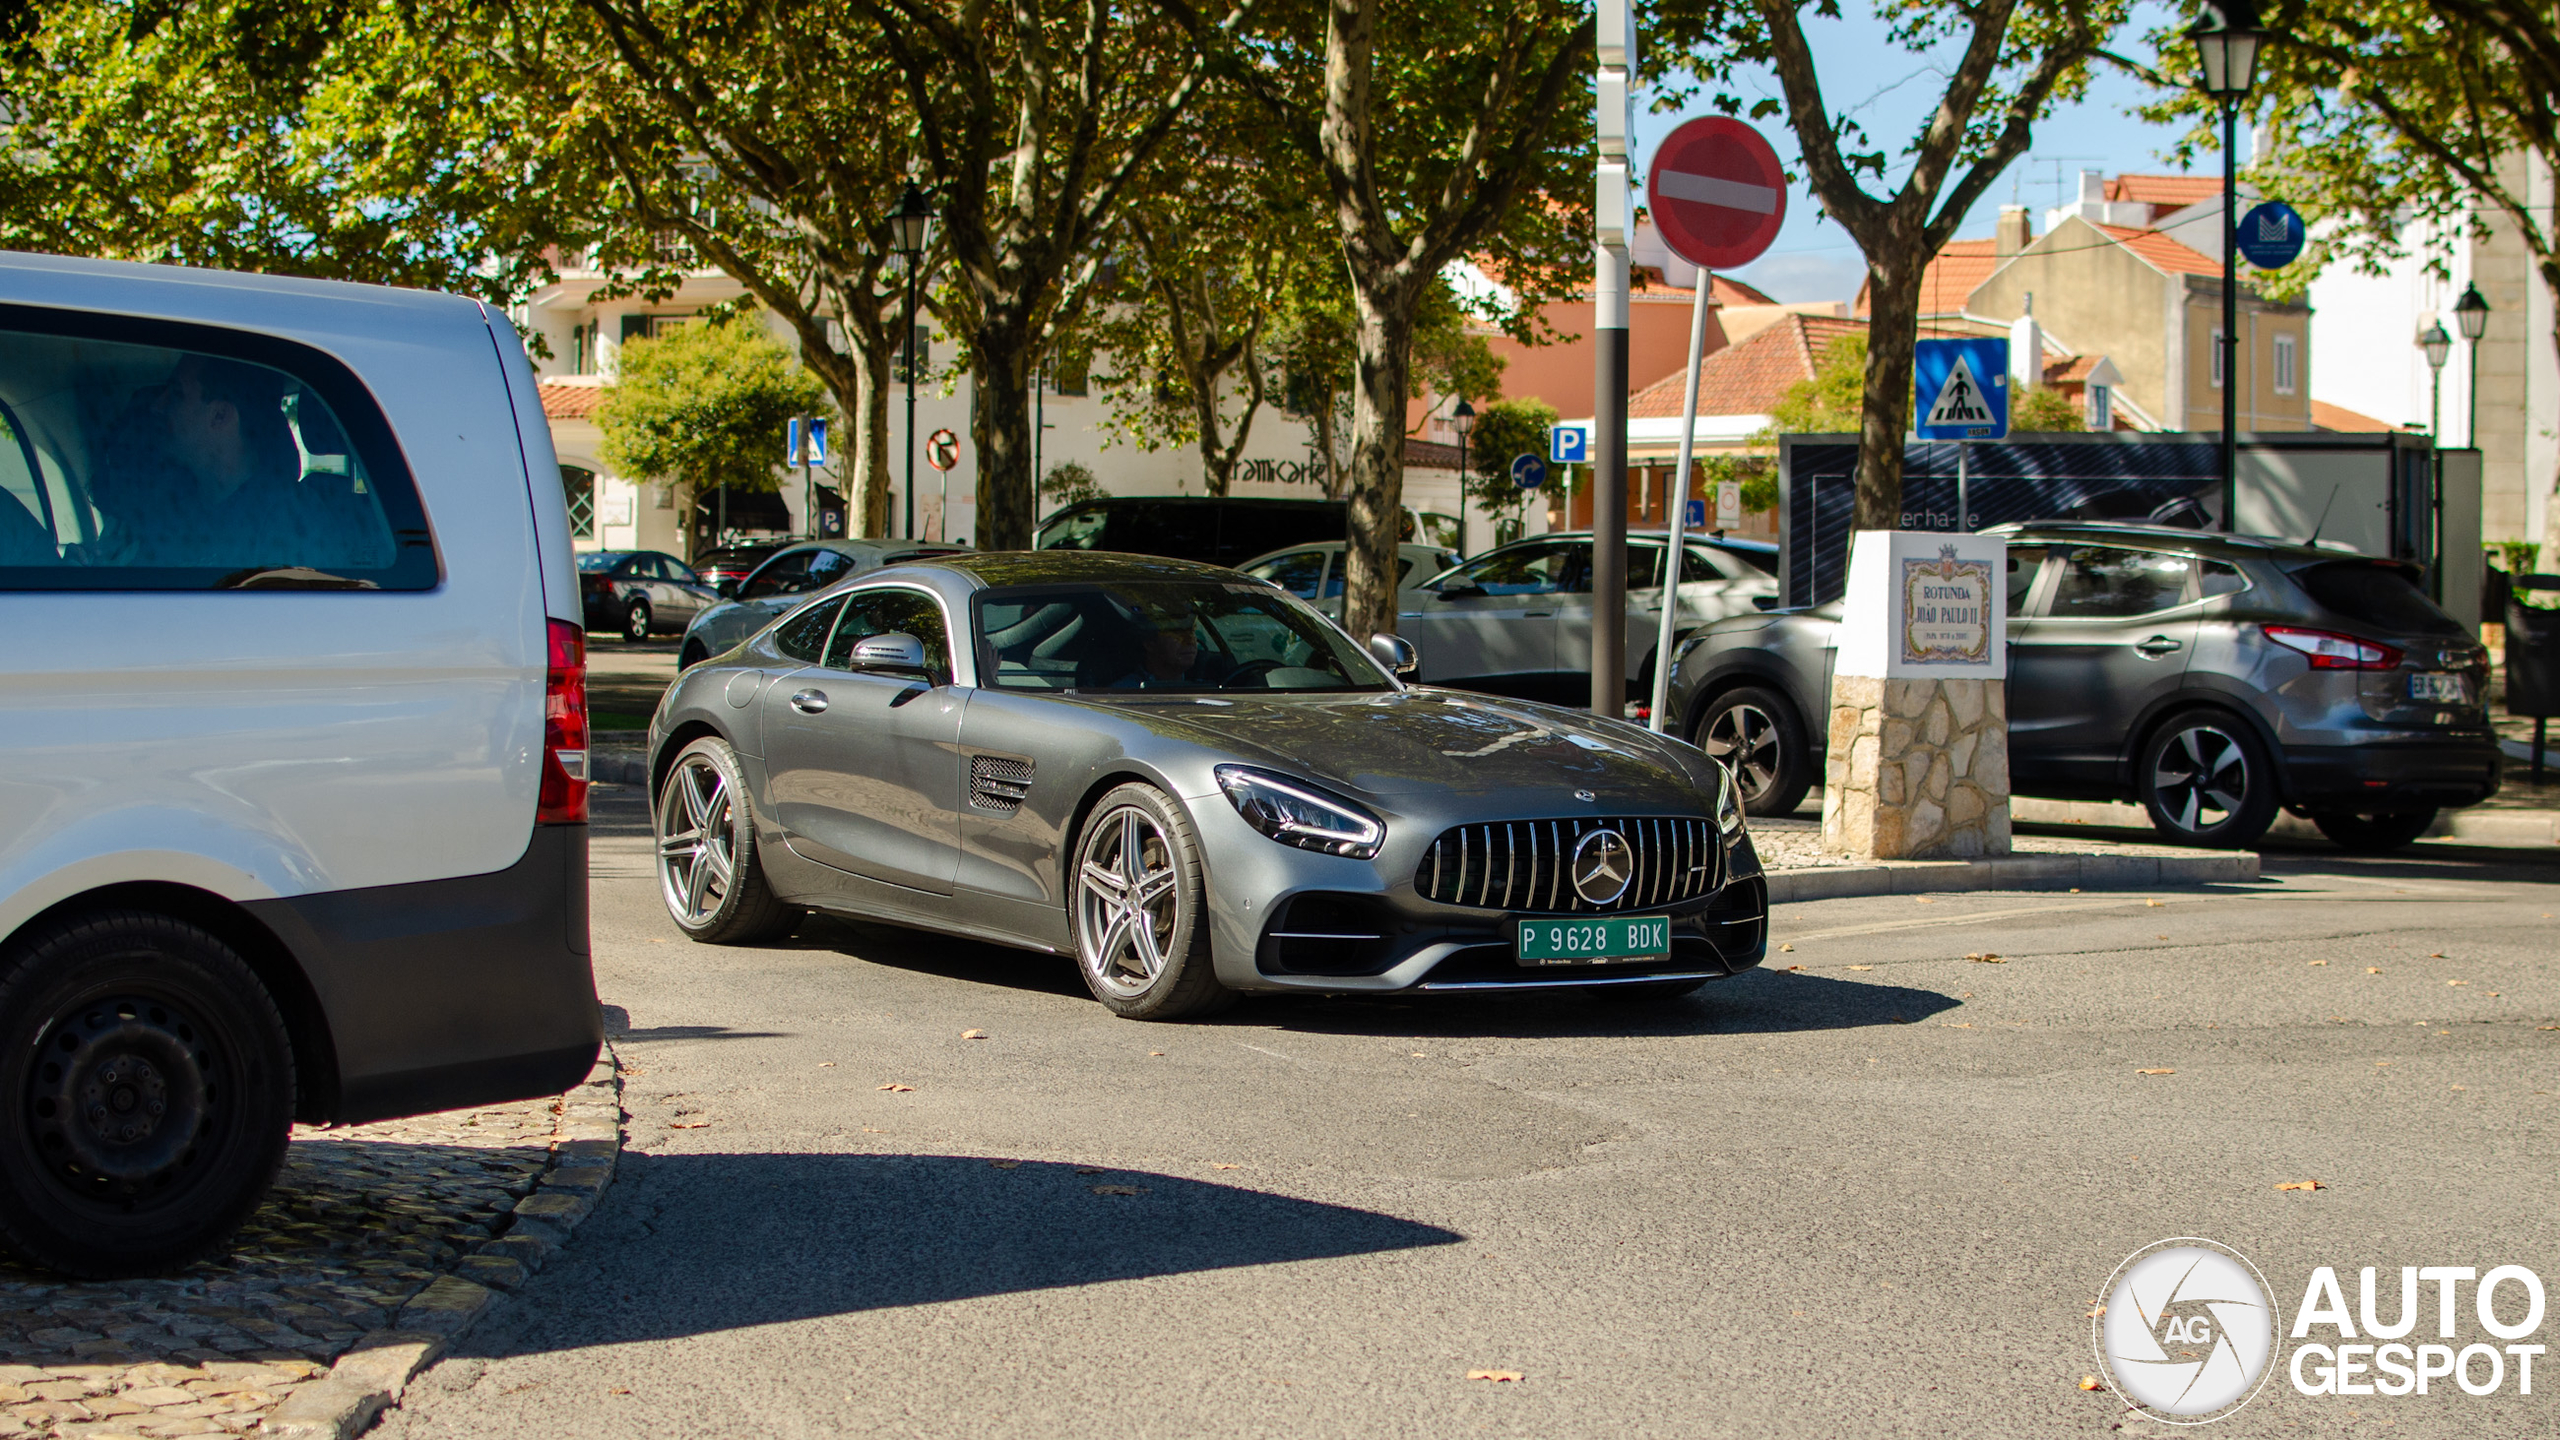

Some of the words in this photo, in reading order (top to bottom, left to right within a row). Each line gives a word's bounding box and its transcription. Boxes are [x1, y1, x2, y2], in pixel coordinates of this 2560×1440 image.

[1558, 429, 1580, 459] P
[1923, 586, 1971, 600] ROTUNDA
[1915, 603, 1937, 624] JOÃO
[1941, 607, 1968, 624] PAULO
[1969, 608, 1978, 625] II
[1523, 928, 1536, 953] P
[1550, 926, 1607, 952] 9628
[1628, 923, 1663, 949] BDK
